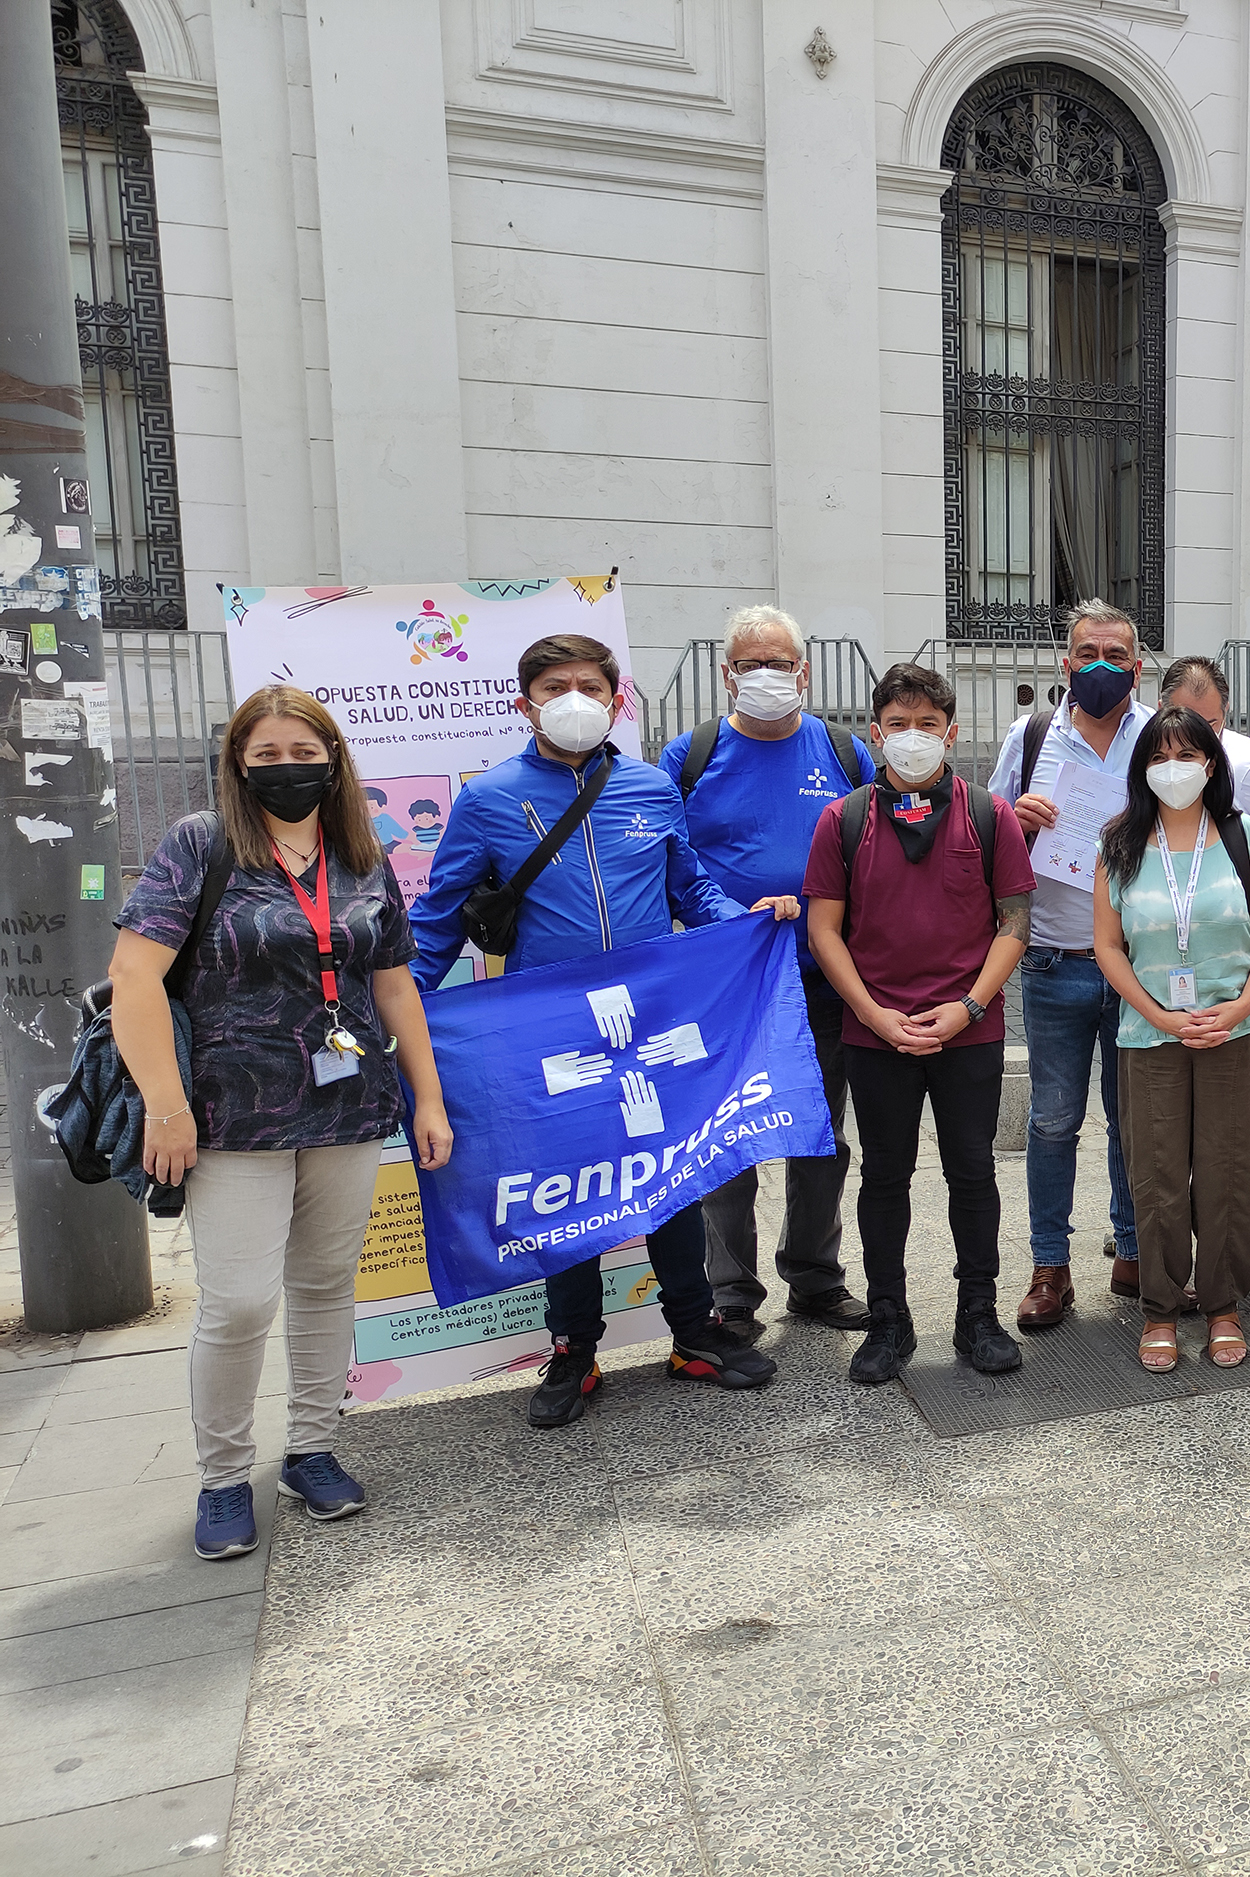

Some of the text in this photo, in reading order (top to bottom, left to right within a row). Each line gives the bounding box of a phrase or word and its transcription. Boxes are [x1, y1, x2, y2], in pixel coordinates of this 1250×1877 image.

[348, 705, 413, 724] SALUD,
[418, 703, 445, 720] UN
[411, 726, 494, 742] constitucional
[799, 787, 838, 799] Fenpruss
[625, 830, 658, 838] Fenpruss
[1, 944, 42, 967] A LA
[6, 974, 79, 997] KALLE
[495, 1071, 773, 1227] Fenpruss
[498, 1110, 794, 1263] PROFESIONALES DE LA SALUD
[378, 1190, 418, 1204] sistem
[387, 1201, 421, 1216] salud
[365, 1215, 423, 1234] inanciad
[359, 1243, 424, 1262] generales
[360, 1257, 427, 1274] específico
[390, 1317, 411, 1328] Los
[416, 1301, 493, 1325] prestadores
[498, 1289, 548, 1309] privados
[391, 1324, 441, 1341] Centros
[446, 1312, 498, 1330] médicos)
[503, 1304, 538, 1319] deben
[602, 1288, 617, 1297] es
[482, 1319, 536, 1336] de lucro.
